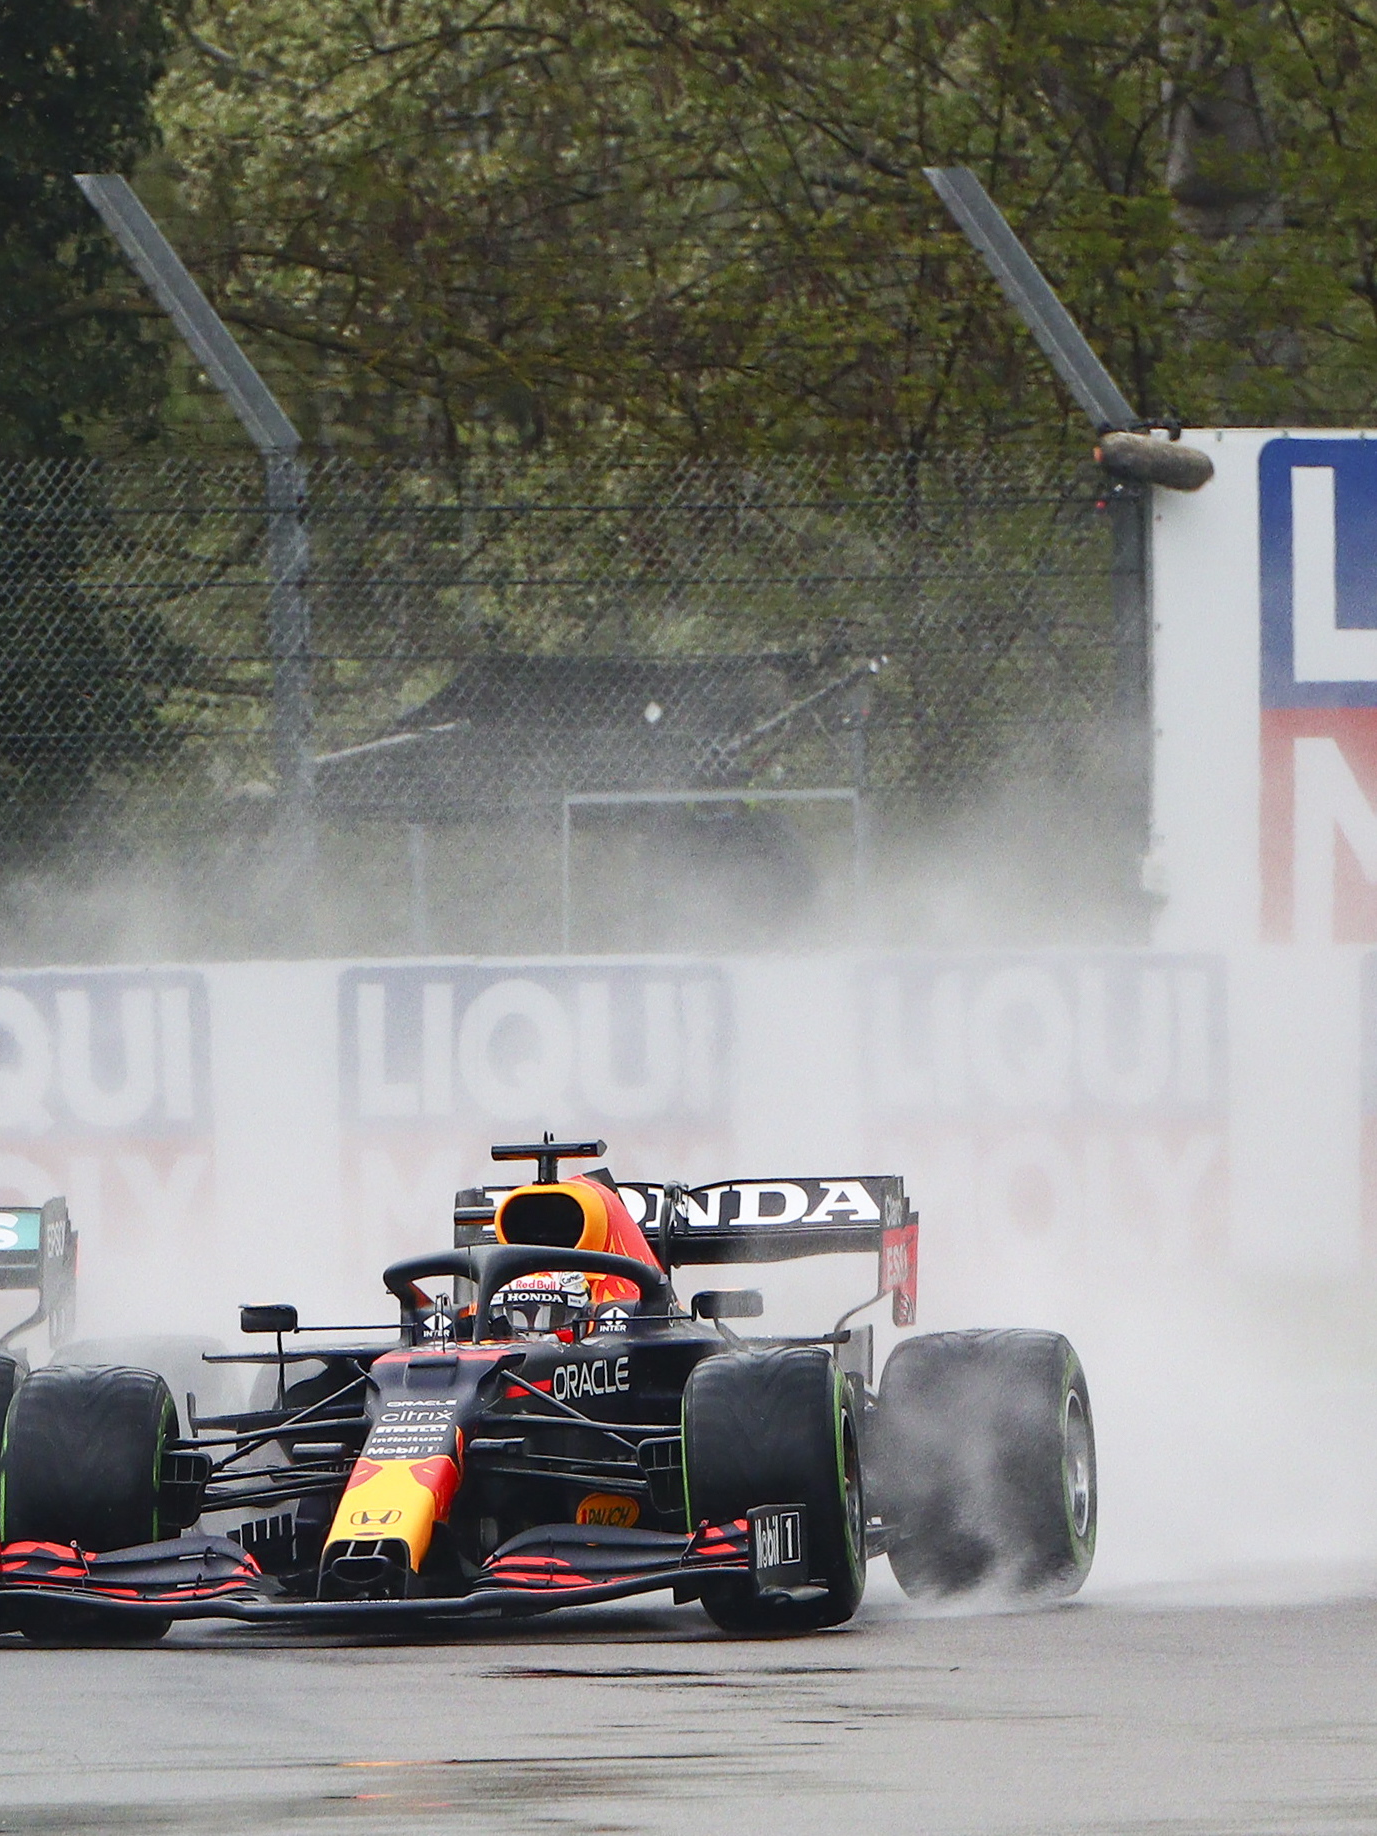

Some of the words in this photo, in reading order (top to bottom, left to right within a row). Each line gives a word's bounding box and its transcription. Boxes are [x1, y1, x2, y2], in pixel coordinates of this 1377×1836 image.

[357, 978, 713, 1126] LIQUI
[516, 1279, 536, 1289] Red
[537, 1279, 556, 1290] Bull
[507, 1293, 564, 1304] HONDA
[423, 1329, 451, 1338] INTER
[599, 1323, 627, 1333] INTER
[554, 1356, 630, 1401] ORACLE
[386, 1400, 458, 1408] ORACLE
[367, 1446, 420, 1455] Mobil
[754, 1515, 780, 1569] Mobil
